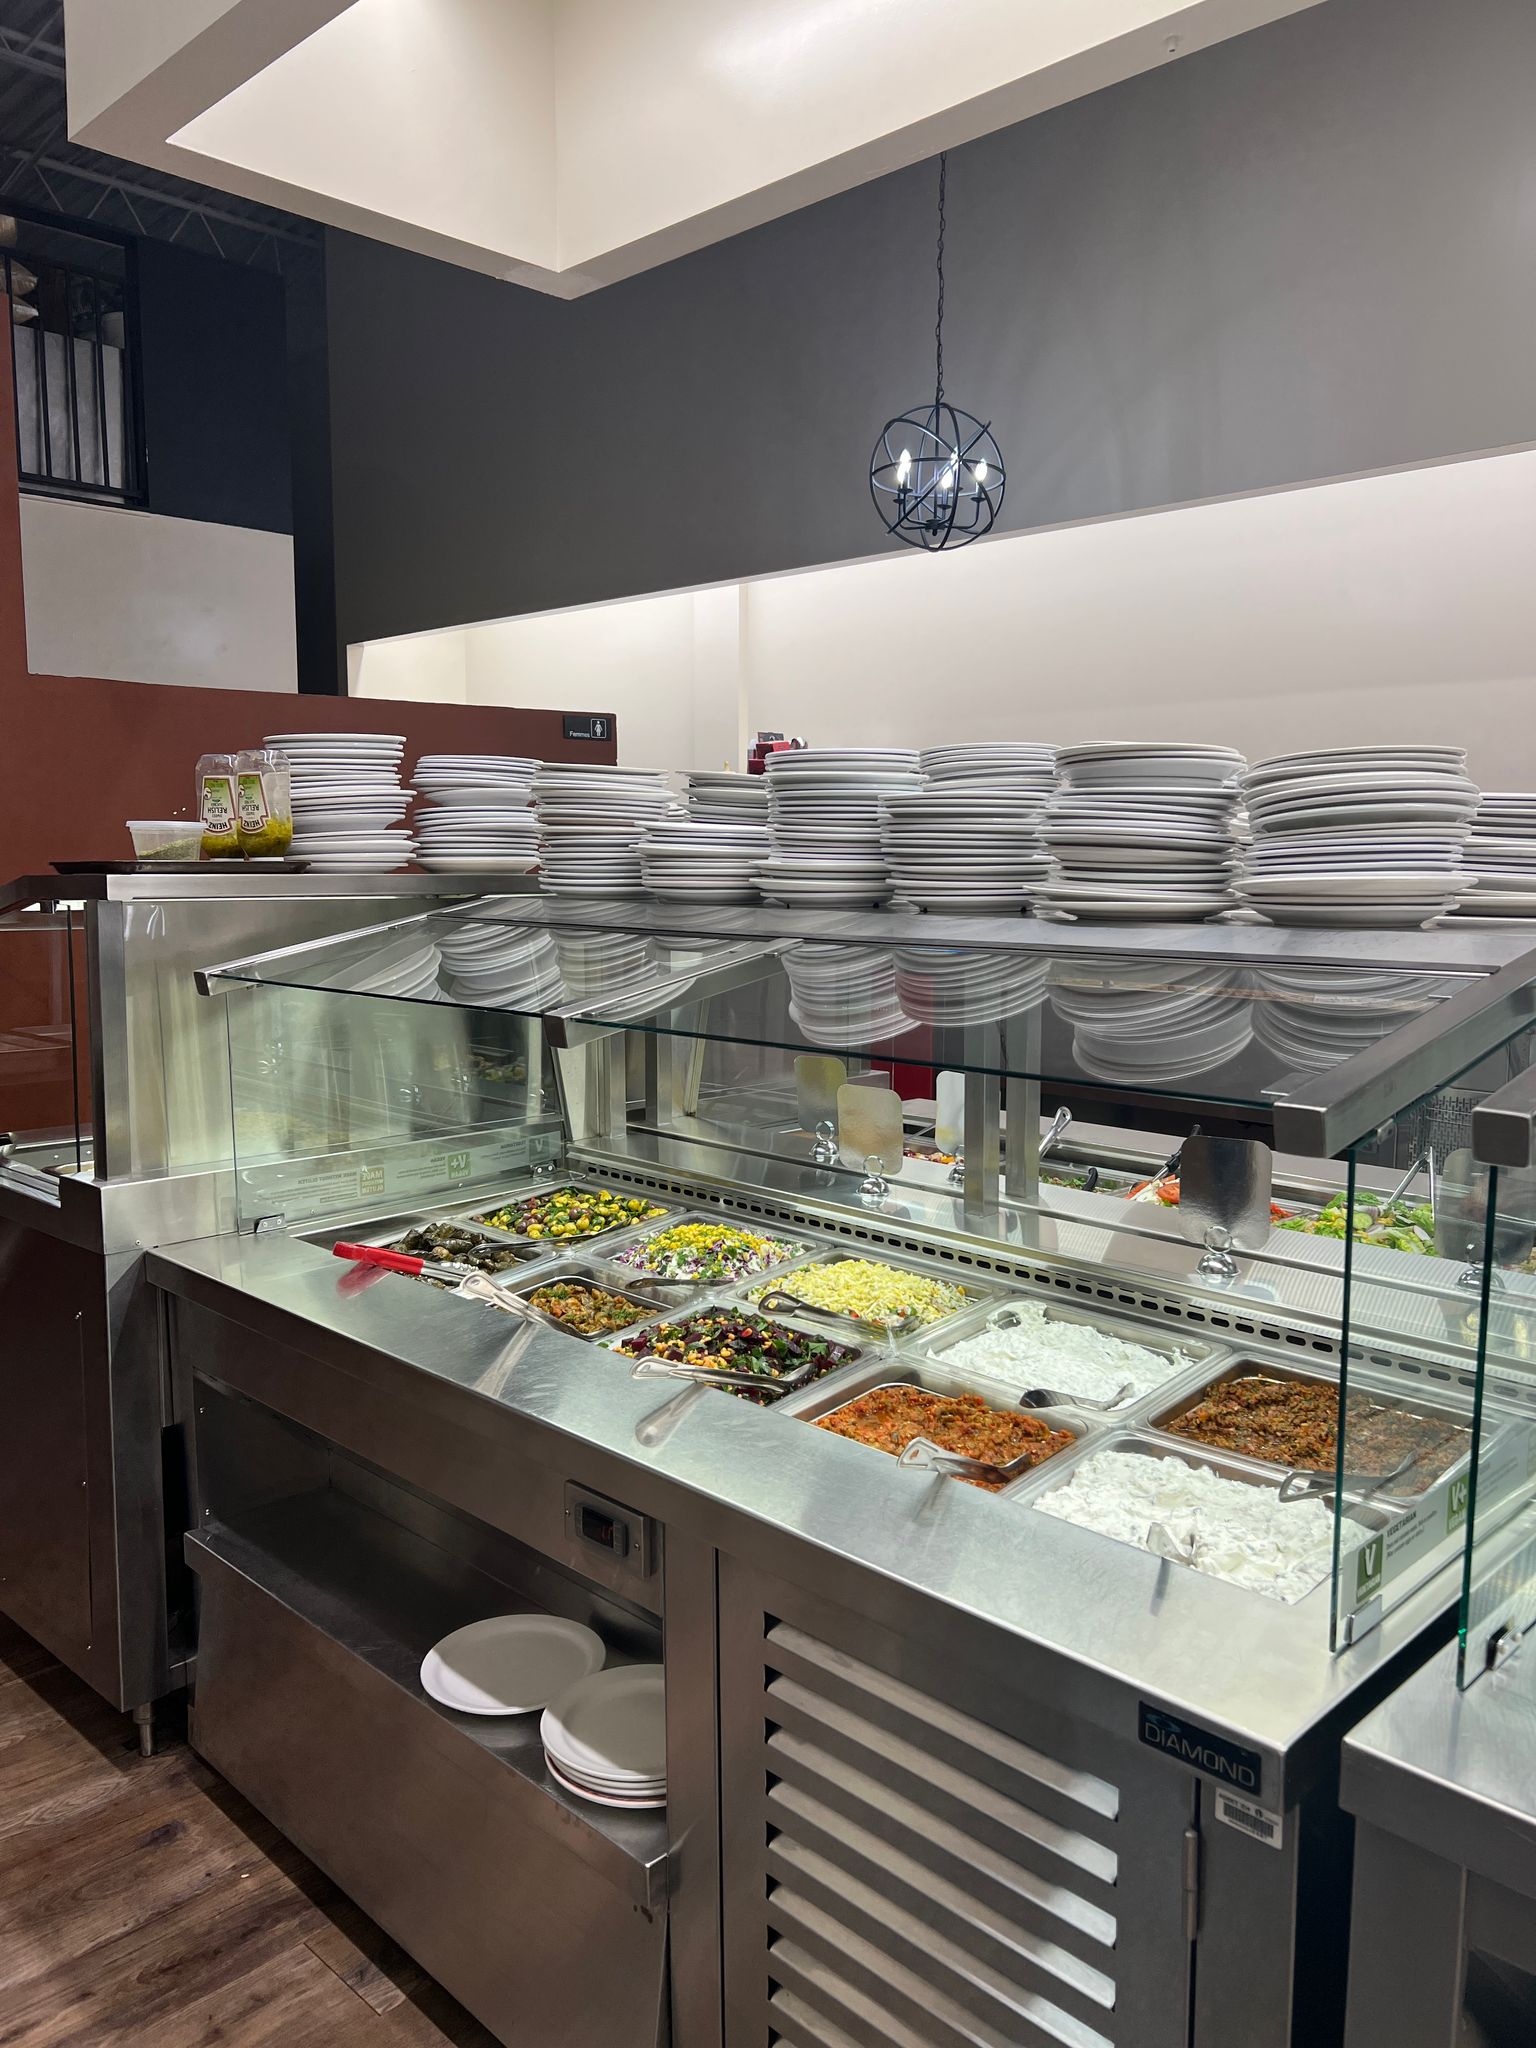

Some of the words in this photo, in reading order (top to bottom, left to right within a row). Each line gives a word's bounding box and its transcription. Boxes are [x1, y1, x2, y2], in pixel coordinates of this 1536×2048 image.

[207, 806, 228, 814] RELISH
[242, 804, 260, 812] RELISH
[208, 821, 228, 830] HEINZ
[243, 819, 260, 828] HEINZ
[1386, 1510, 1417, 1537] VEGETARIAN
[1364, 1543, 1376, 1576] V
[1145, 1722, 1255, 1787] DIAMOND
